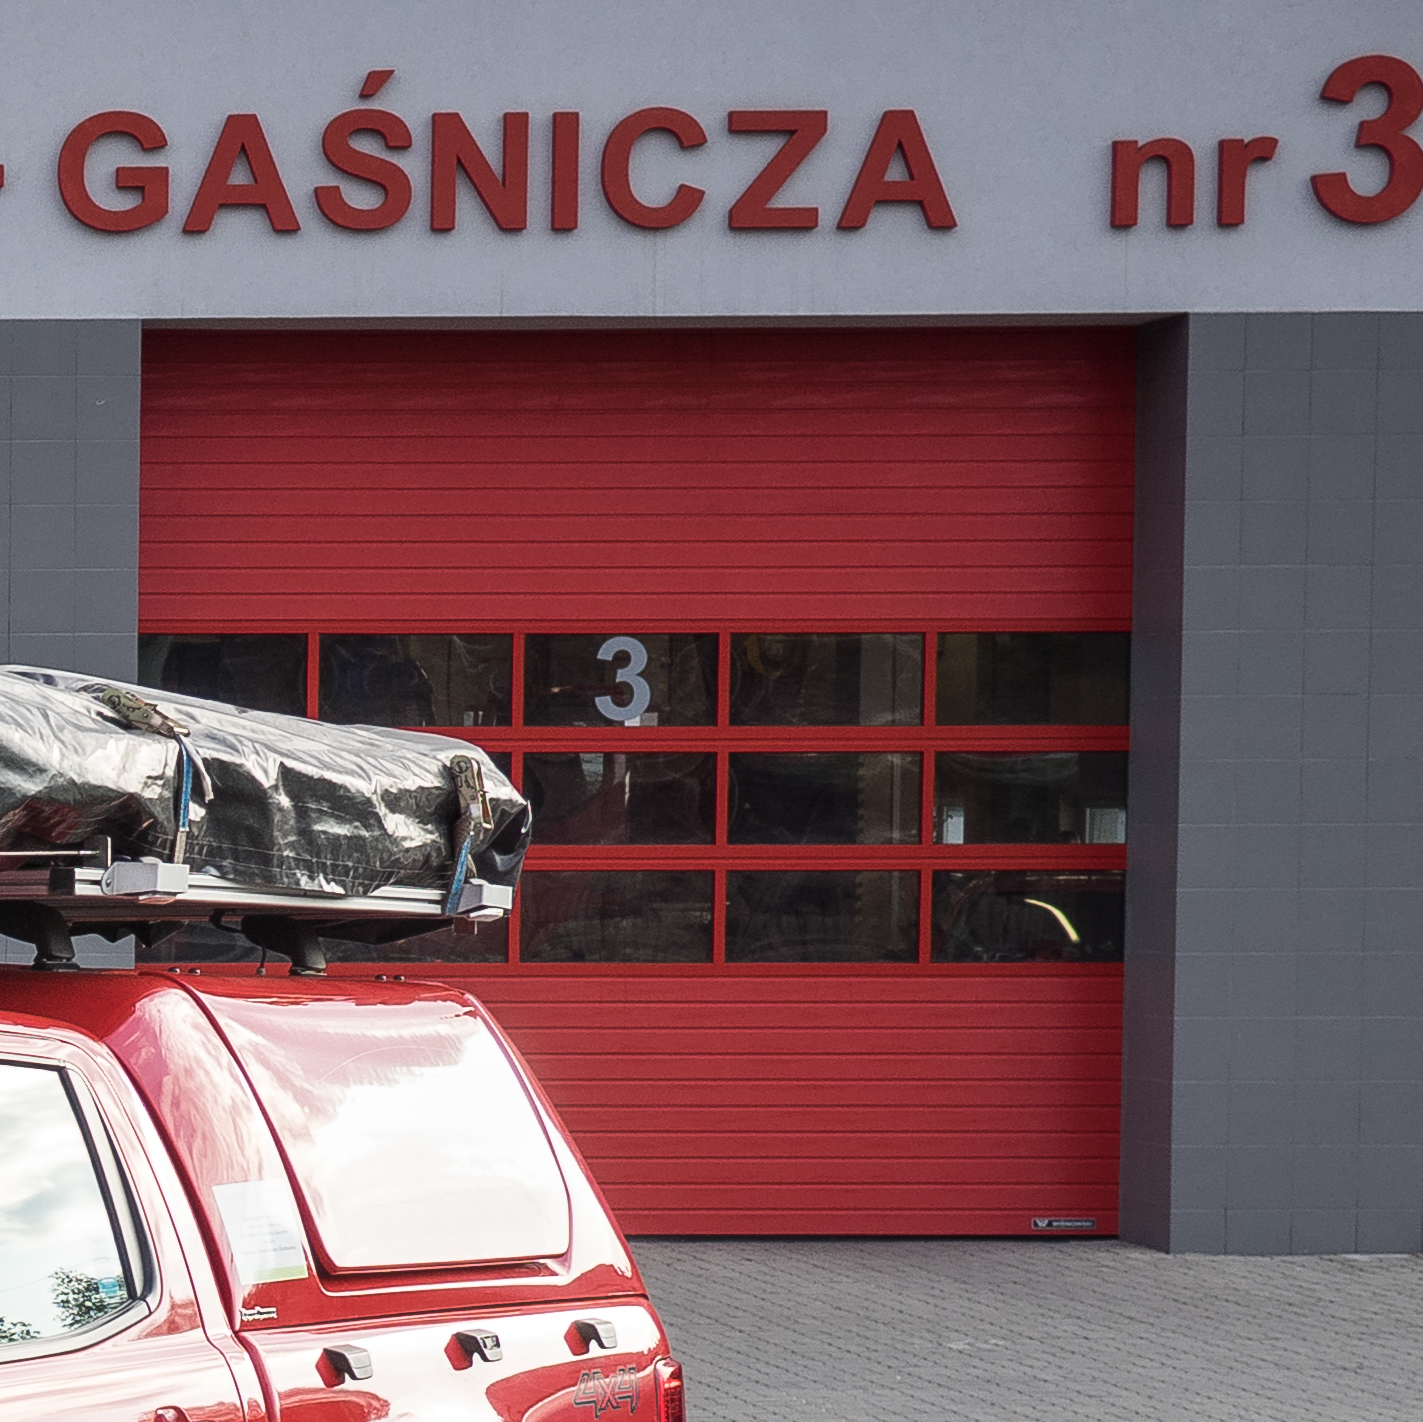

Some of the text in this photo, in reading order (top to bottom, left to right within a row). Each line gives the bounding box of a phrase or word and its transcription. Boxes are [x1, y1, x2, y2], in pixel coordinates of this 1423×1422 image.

[57, 69, 958, 233] GAŚNICZA
[1110, 136, 1279, 227] nr
[1310, 53, 1423, 224] 3
[593, 635, 652, 728] 3
